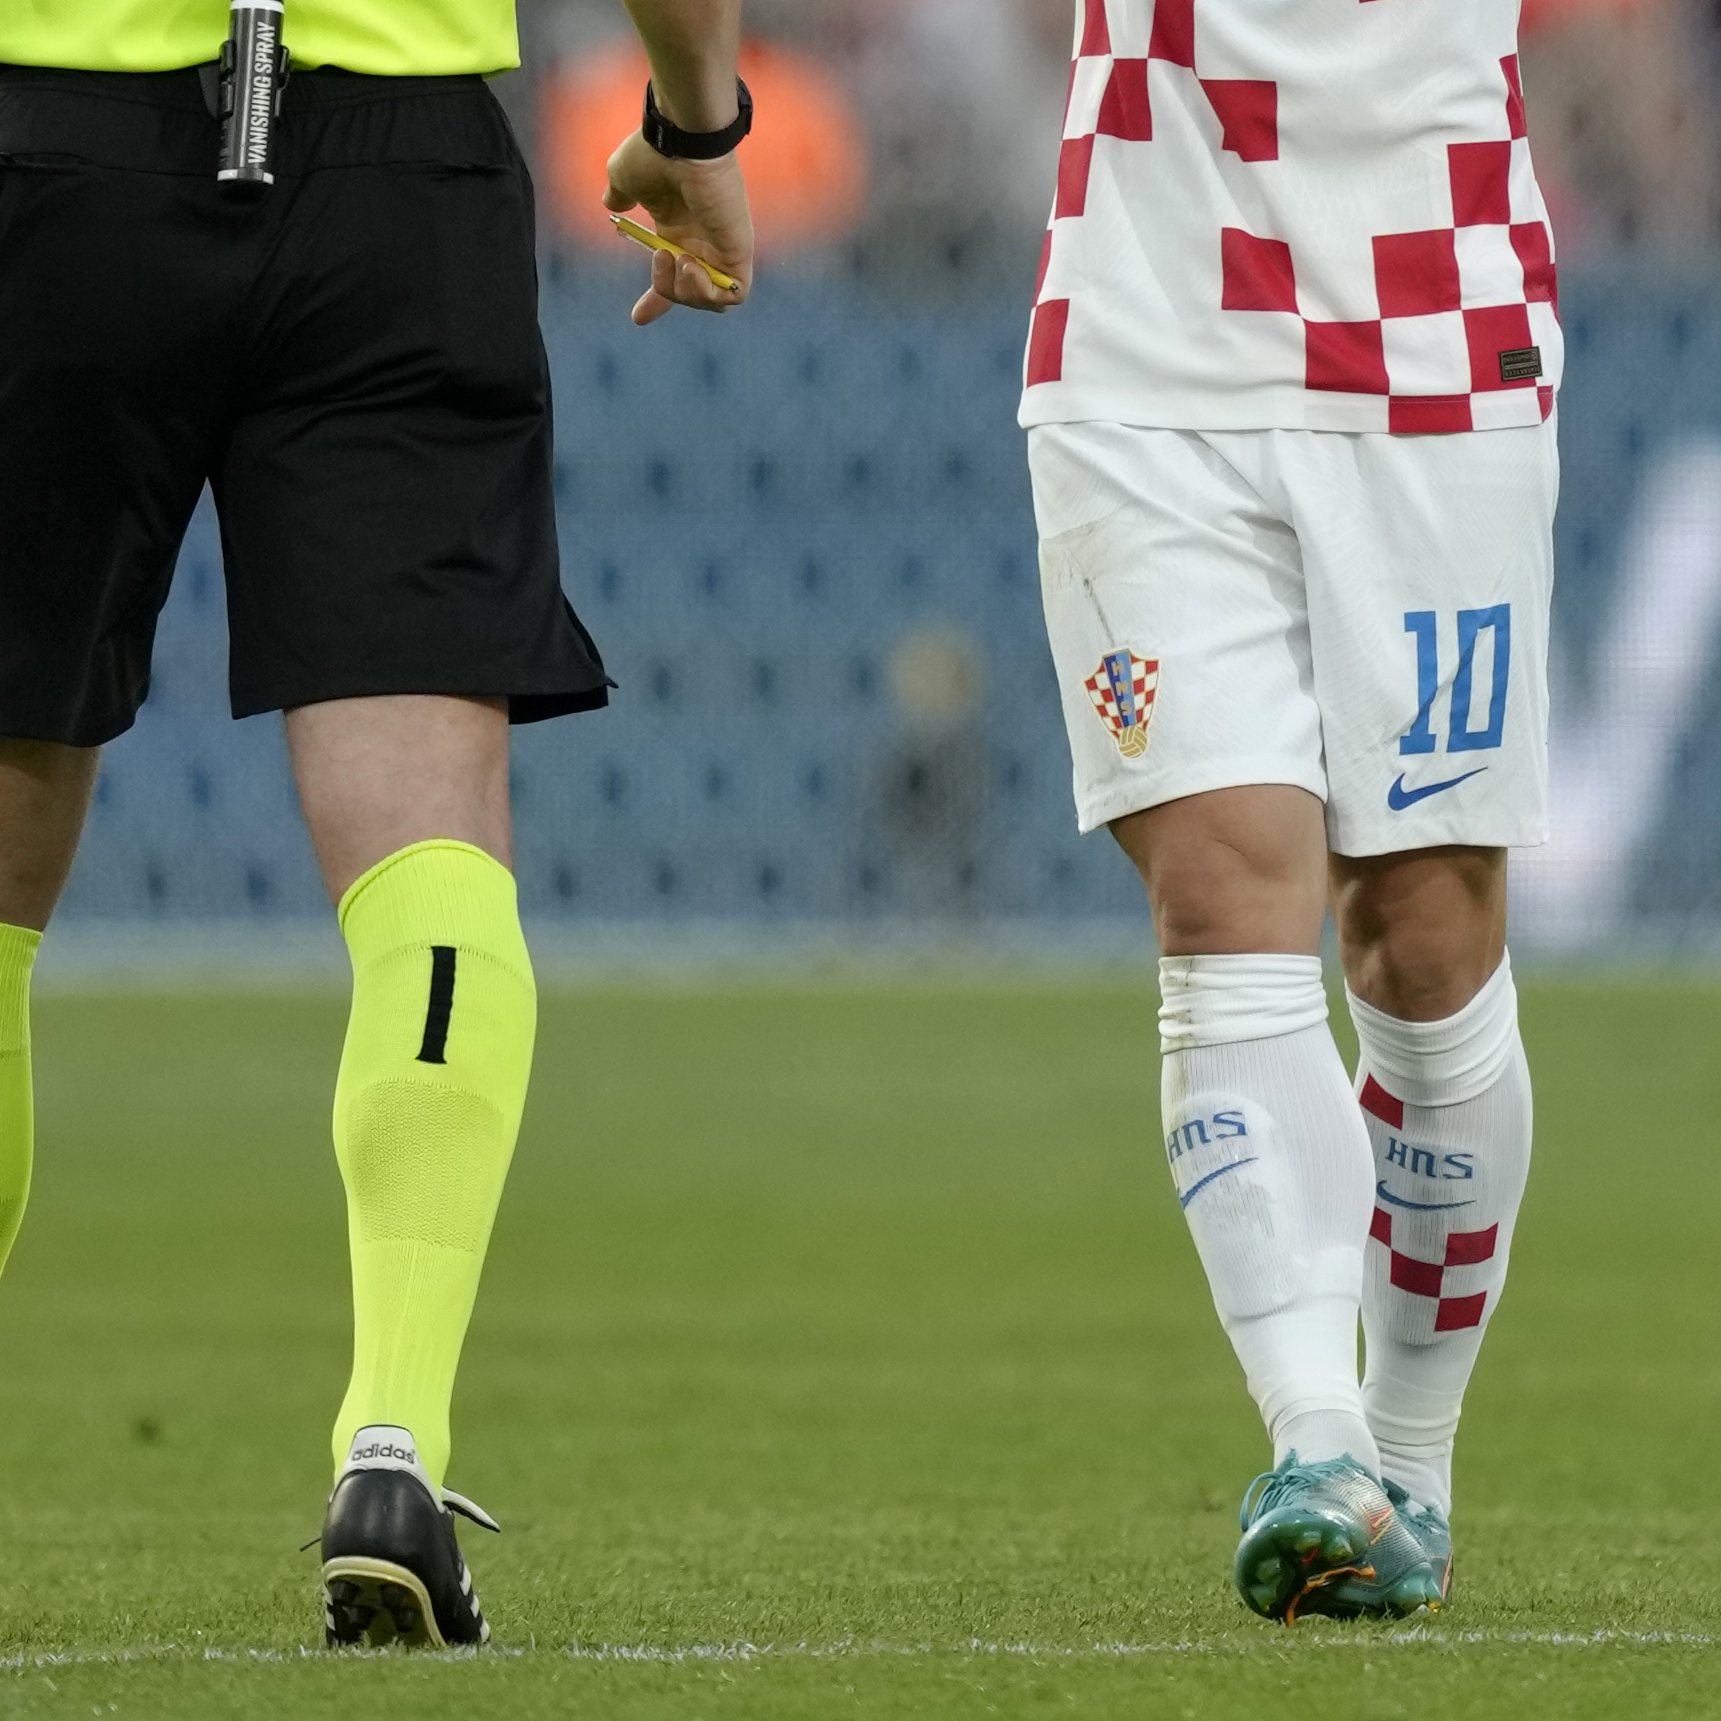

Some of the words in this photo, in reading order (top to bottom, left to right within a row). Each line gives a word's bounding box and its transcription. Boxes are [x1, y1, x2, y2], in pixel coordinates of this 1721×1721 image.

[253, 21, 276, 75] SPRAY
[247, 75, 272, 164] VANISHING
[1398, 602, 1511, 756] 10
[1384, 1136, 1474, 1180] HNS
[351, 1443, 415, 1465] adidas
